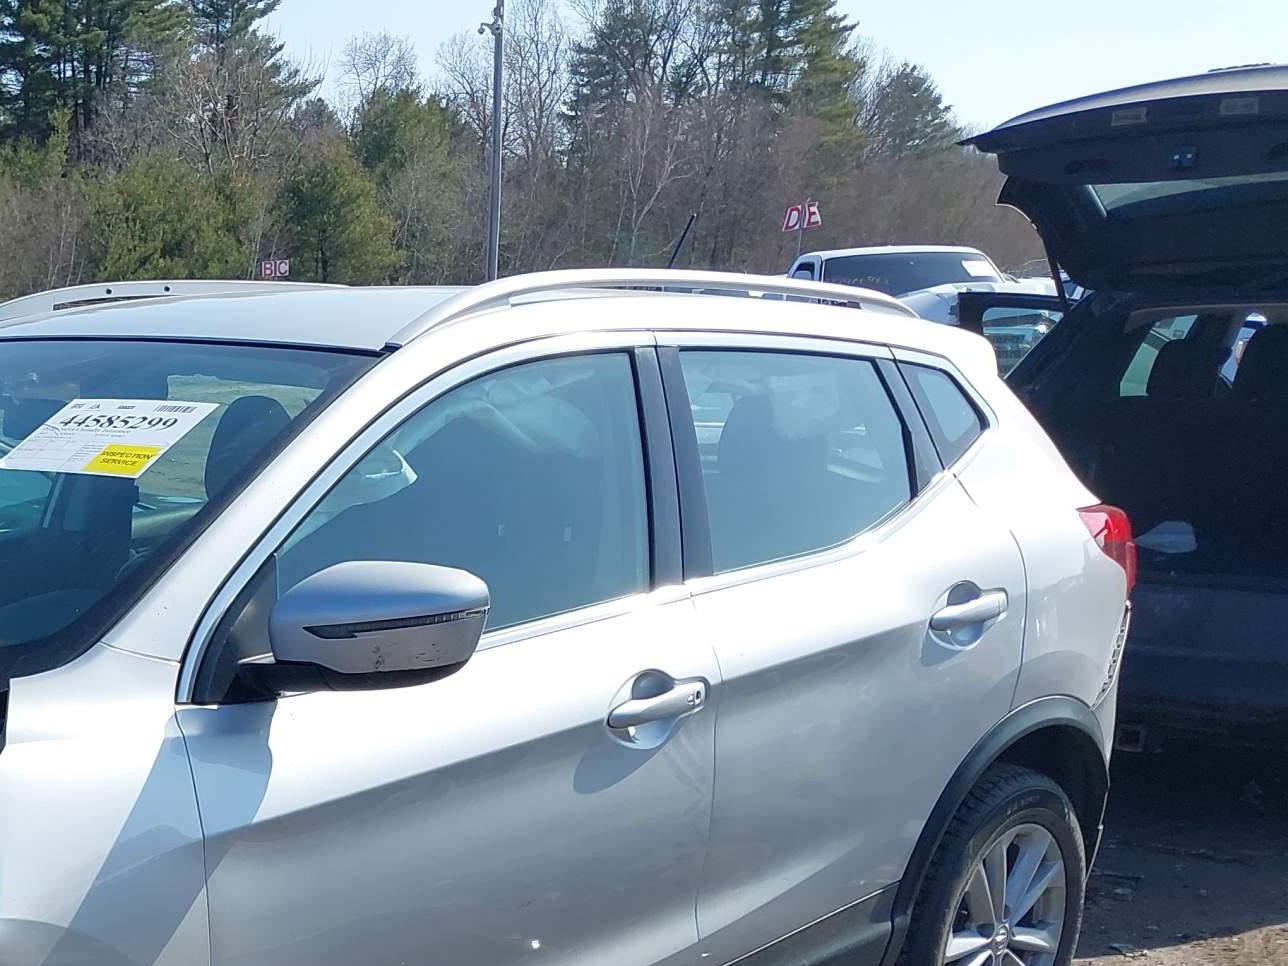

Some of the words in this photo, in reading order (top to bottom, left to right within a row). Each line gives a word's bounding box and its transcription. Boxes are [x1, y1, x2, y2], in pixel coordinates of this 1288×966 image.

[60, 414, 179, 431] 44585299
[101, 450, 154, 460] INSPECTION
[99, 457, 139, 466] SERVICE
